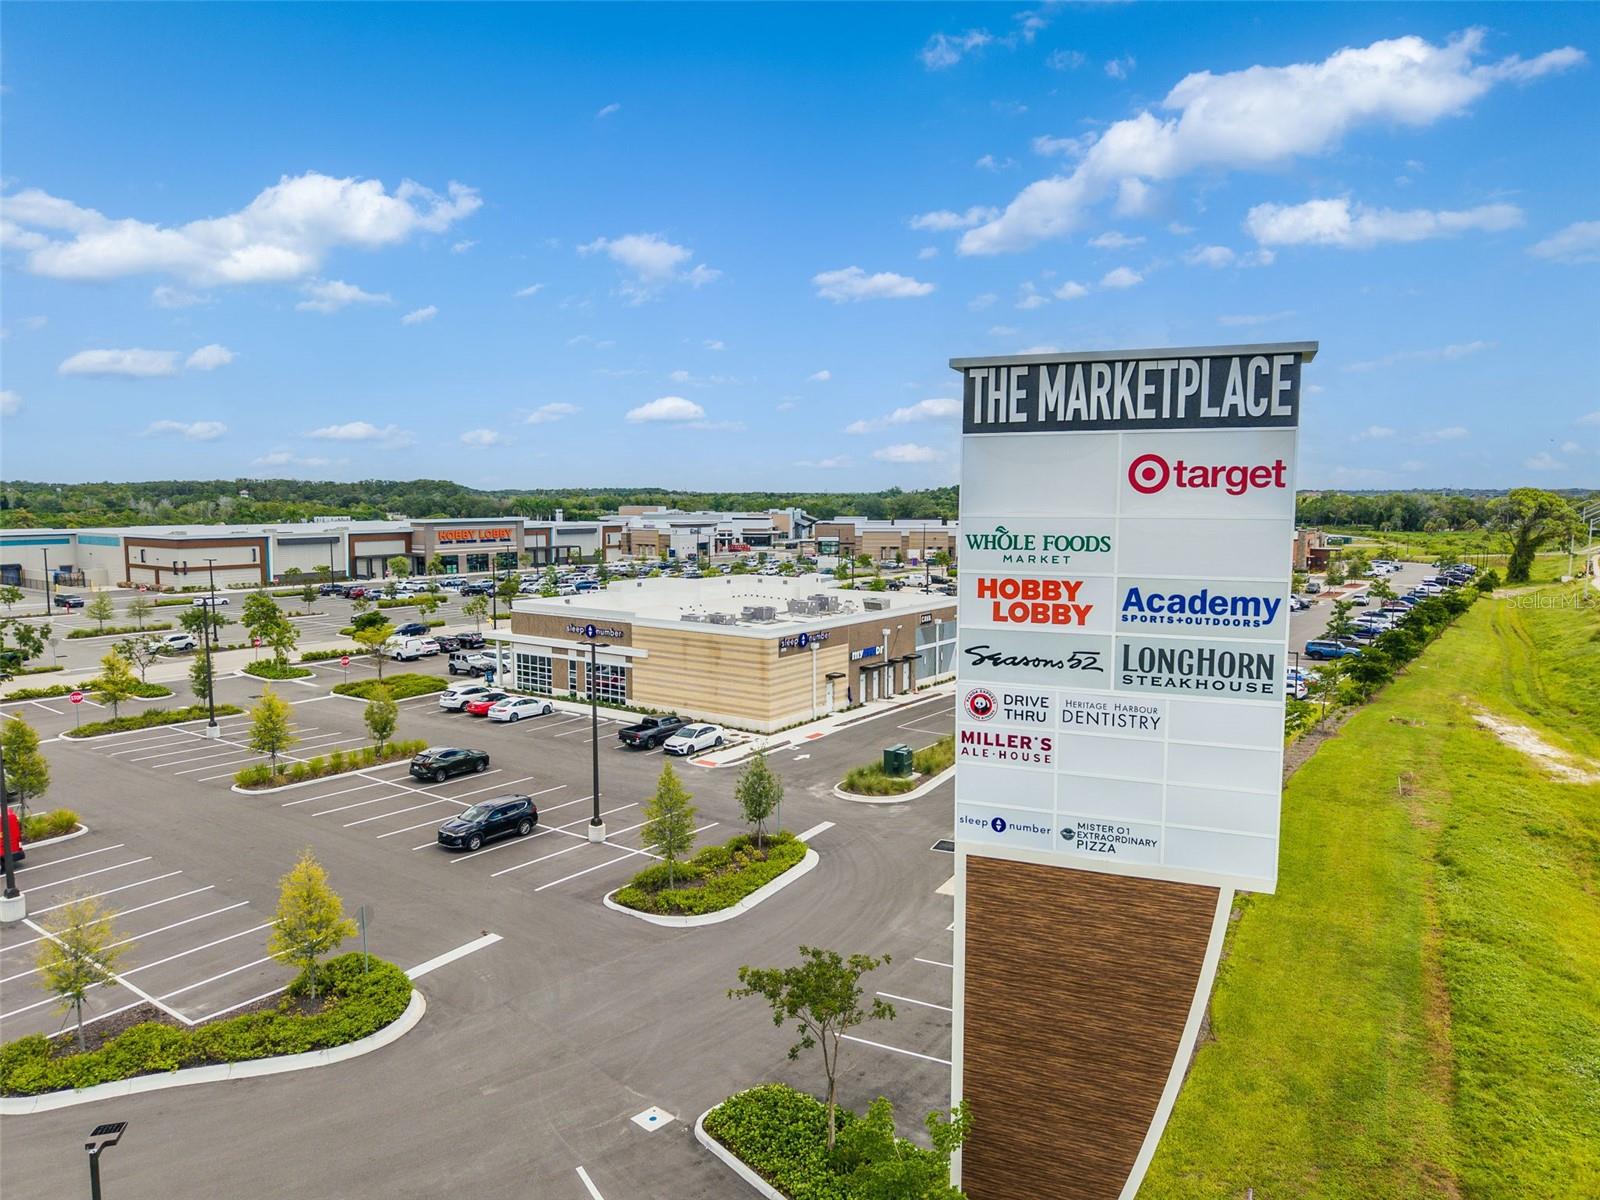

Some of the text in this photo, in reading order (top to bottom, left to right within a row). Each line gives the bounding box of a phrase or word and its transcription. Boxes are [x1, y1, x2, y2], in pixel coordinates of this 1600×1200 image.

[969, 355, 1295, 424] THE MARKETPLACE
[1174, 459, 1286, 495] target
[479, 528, 512, 539] LOBBY
[966, 528, 1112, 553] WHOLE FOODS
[1003, 554, 1071, 565] MARKET
[977, 578, 1084, 602] HOBBY
[992, 602, 1093, 626] LOBBY
[1122, 587, 1281, 625] Academy
[964, 645, 1104, 673] Seasons 52
[1122, 674, 1274, 695] STEAKHOUSE
[1003, 694, 1049, 708] DRIVE
[1065, 698, 1158, 715] HERITAGE HARBOUR
[1003, 708, 1046, 723] THRU
[1062, 709, 1161, 731] DENTISTRY
[961, 730, 1052, 751] MILLER'S
[959, 814, 1052, 836] sleep number
[1077, 822, 1114, 833] MISTER
[1077, 831, 1158, 848] EXTRAORDINARY
[1077, 840, 1117, 854] PIZZA
